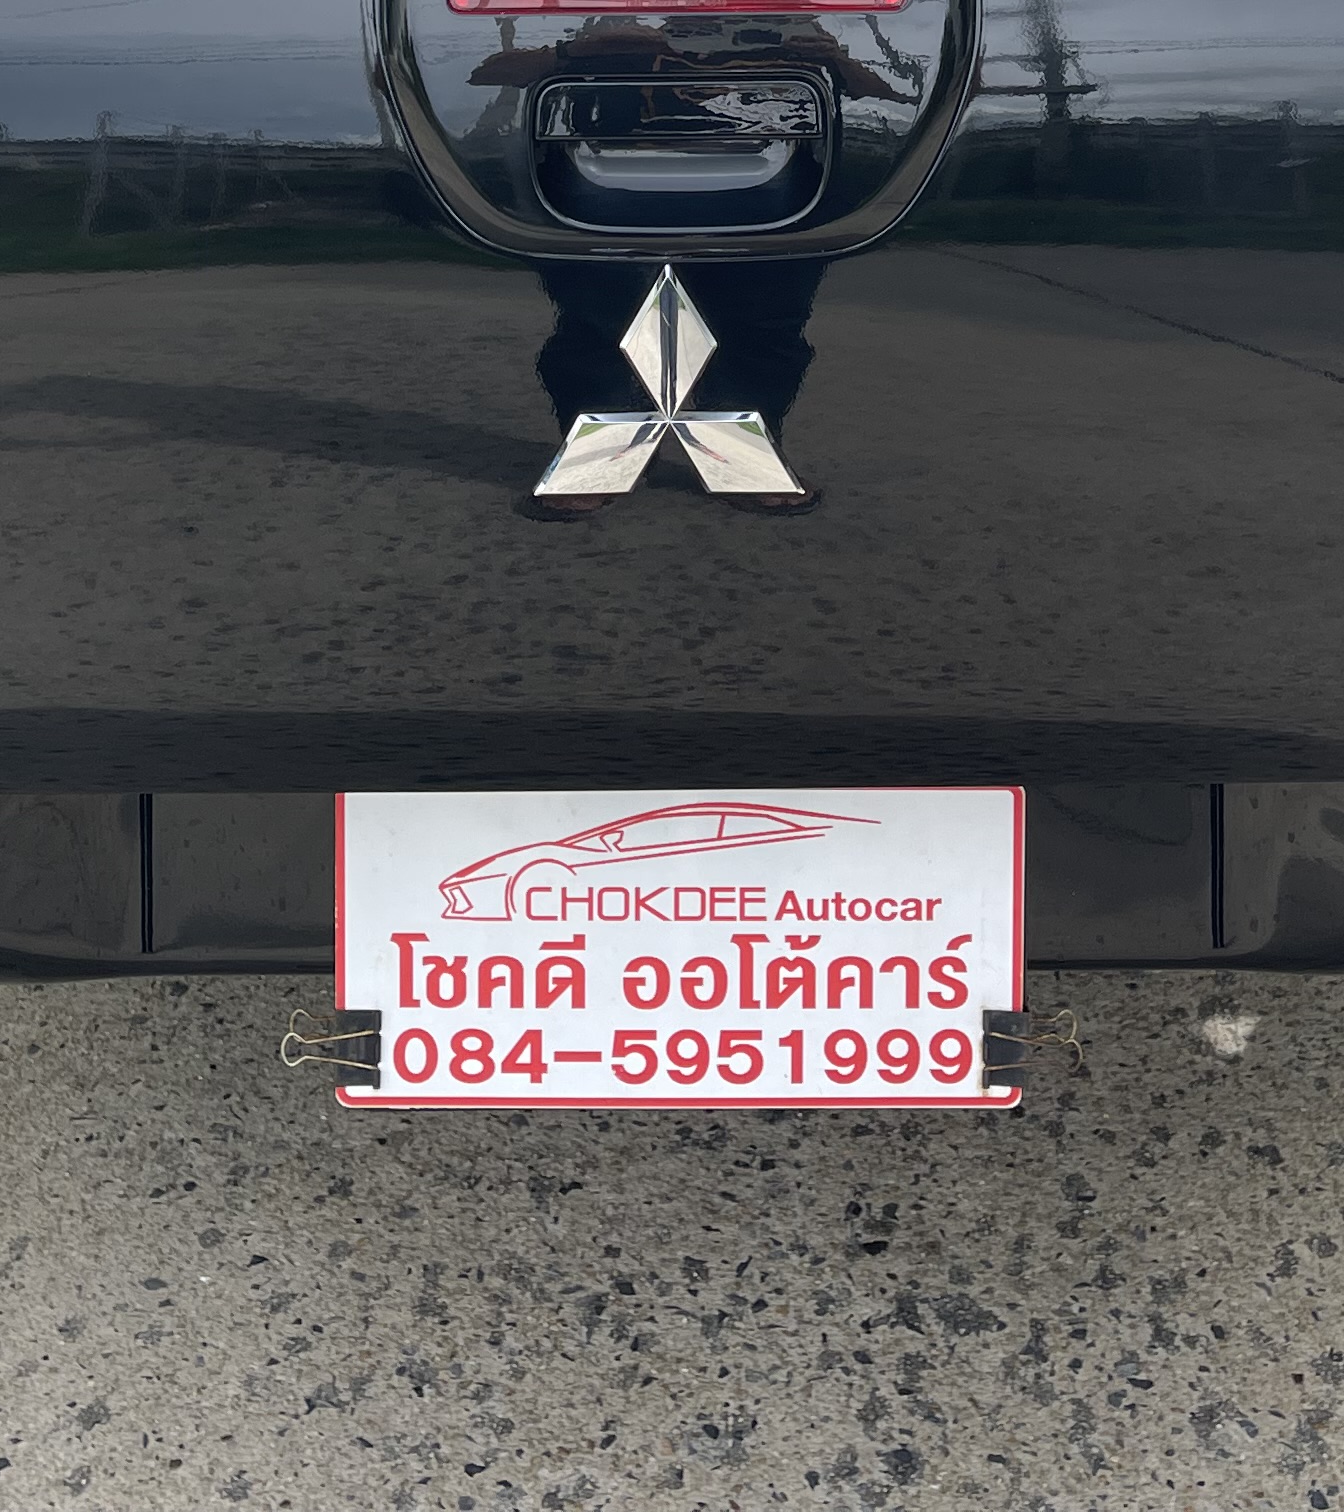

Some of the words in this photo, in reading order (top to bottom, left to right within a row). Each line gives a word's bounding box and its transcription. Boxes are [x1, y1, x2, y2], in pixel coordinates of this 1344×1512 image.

[525, 886, 767, 922] CHOKDEE
[775, 890, 942, 922] Autocar
[391, 932, 586, 1009] โชคดี
[623, 933, 972, 1010] ออโต้คาร์
[393, 1027, 973, 1085] 084-5951999
